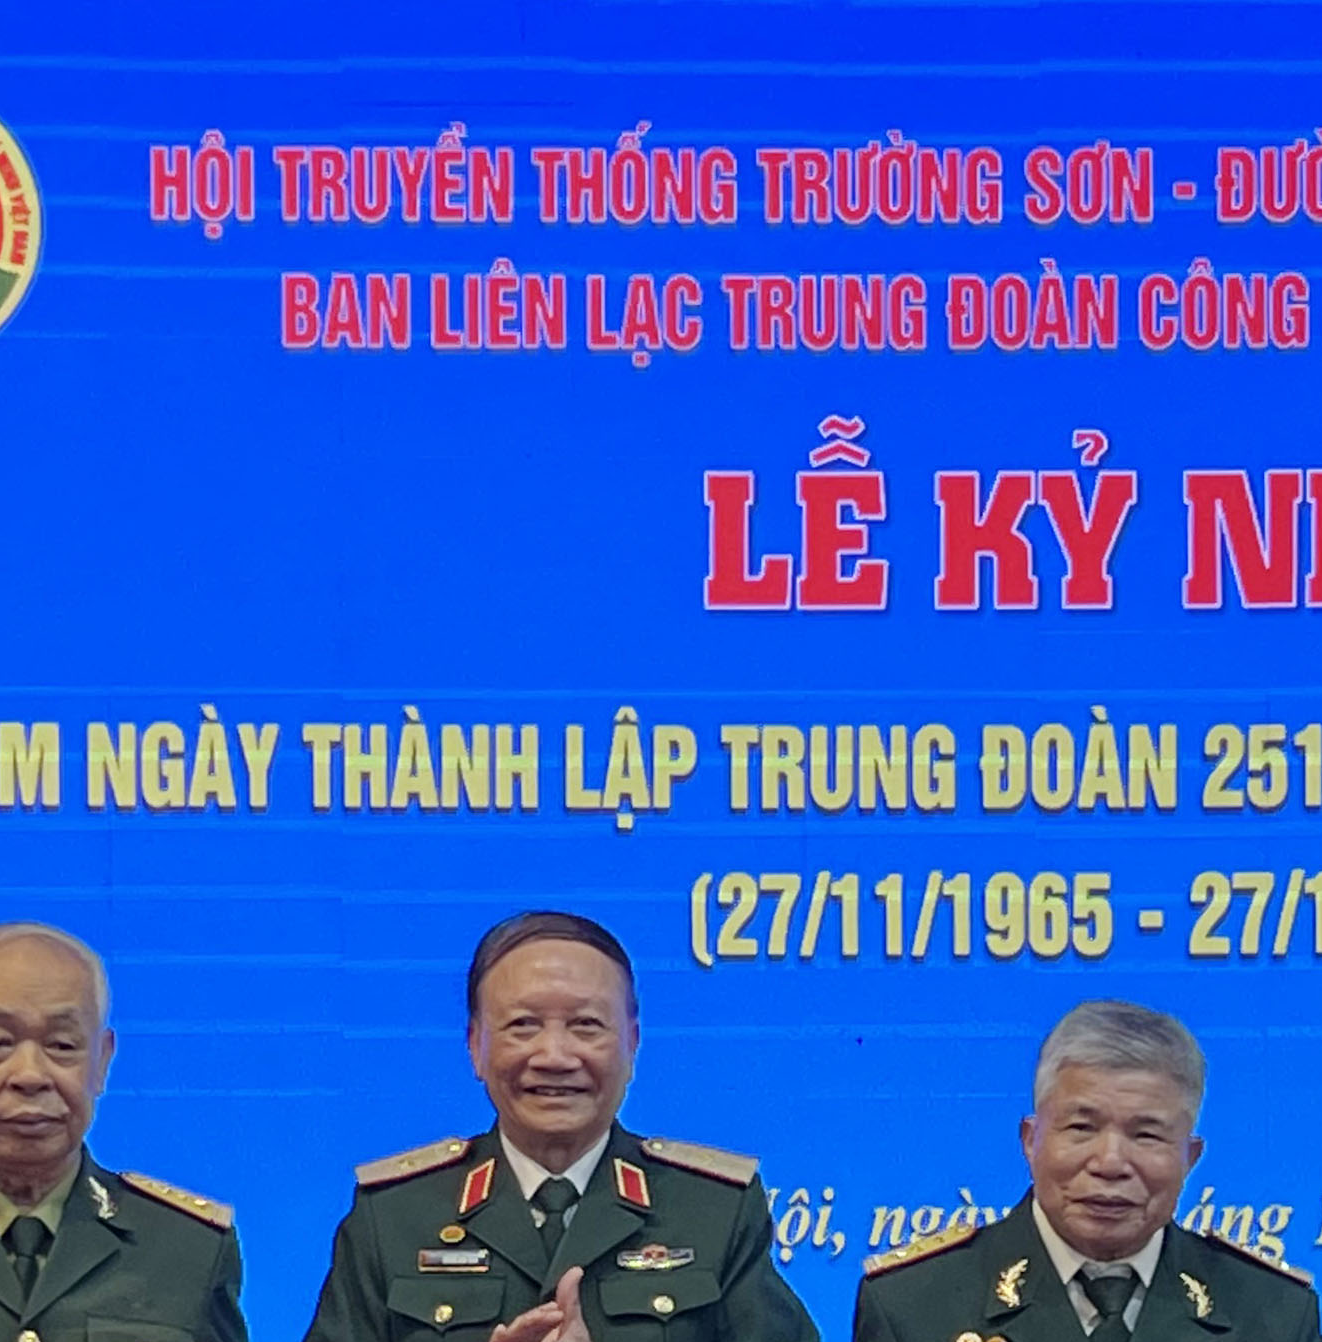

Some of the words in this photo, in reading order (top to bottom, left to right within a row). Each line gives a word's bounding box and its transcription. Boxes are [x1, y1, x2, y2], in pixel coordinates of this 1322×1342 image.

[150, 128, 254, 239] HỘI
[274, 120, 513, 225] TRUYỀN
[532, 120, 737, 226] THỐNG
[757, 128, 1002, 226] TRƯỜNG
[1025, 139, 1153, 226] SƠN
[1173, 181, 1197, 200] -
[281, 273, 412, 350] BAN
[430, 256, 567, 351] LIÊN
[586, 272, 703, 368] LẠC
[721, 274, 928, 352] TRUNG
[945, 257, 1119, 352] ĐOÀN
[1139, 256, 1311, 352] CÔNG
[702, 413, 889, 612] LỄ
[933, 428, 1139, 612] KỶ
[87, 704, 279, 810] NGÀY
[302, 705, 539, 810] THÀNH
[565, 706, 697, 830] LẬP
[721, 724, 957, 811] TRUNG
[979, 705, 1178, 810] ĐOÀN
[1202, 723, 1322, 809] 251
[691, 871, 1114, 967] (27/11/1965
[1139, 910, 1165, 928] -
